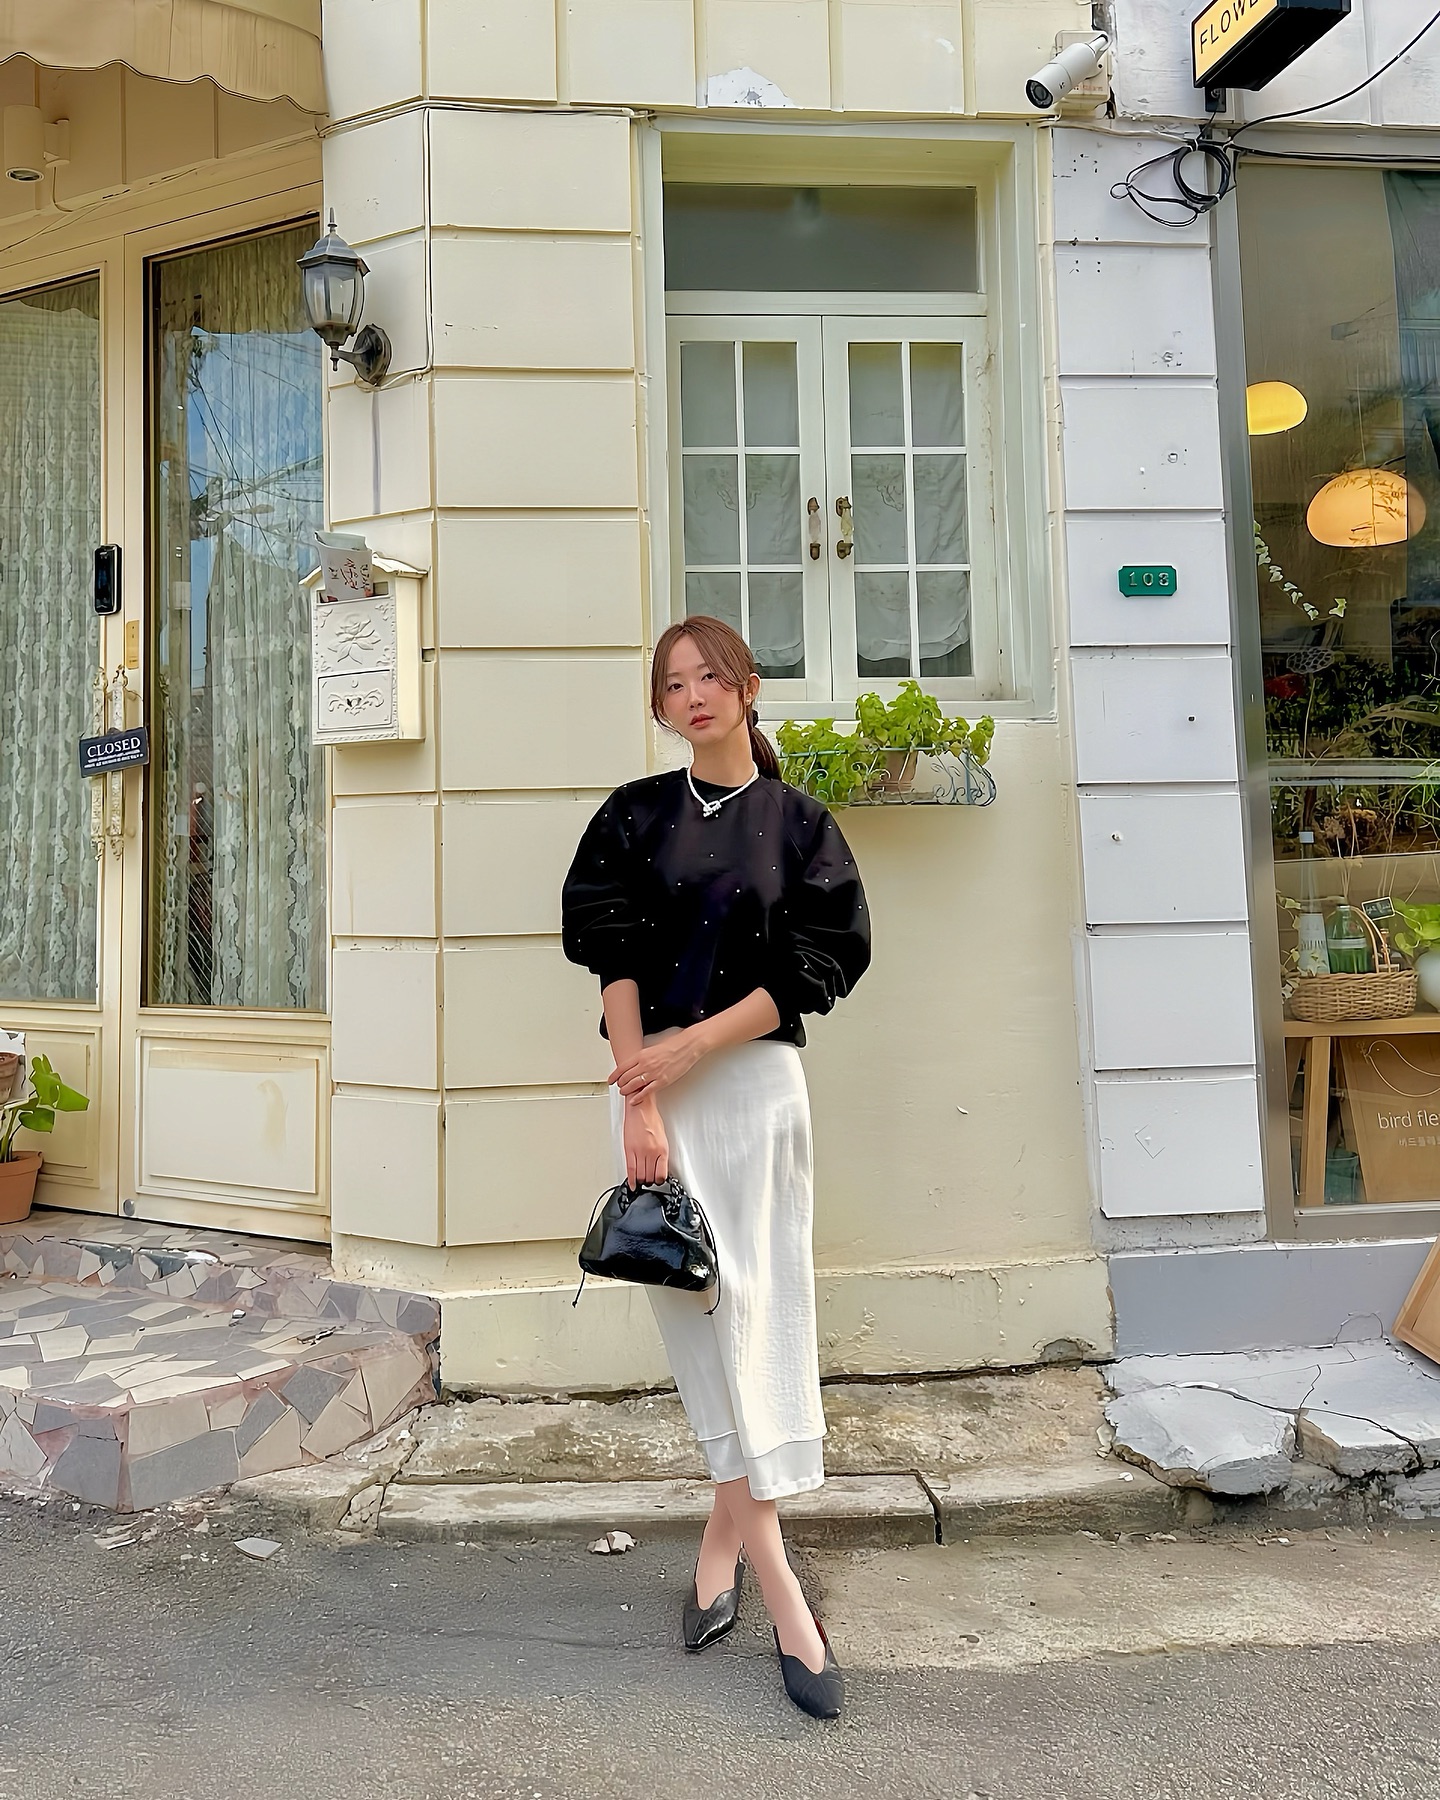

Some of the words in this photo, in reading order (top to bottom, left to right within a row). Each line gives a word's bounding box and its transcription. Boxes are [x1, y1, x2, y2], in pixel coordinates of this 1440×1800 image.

[87, 737, 141, 758] CLOSED
[1377, 1110, 1412, 1129] bird
[1417, 1109, 1440, 1126] fle
